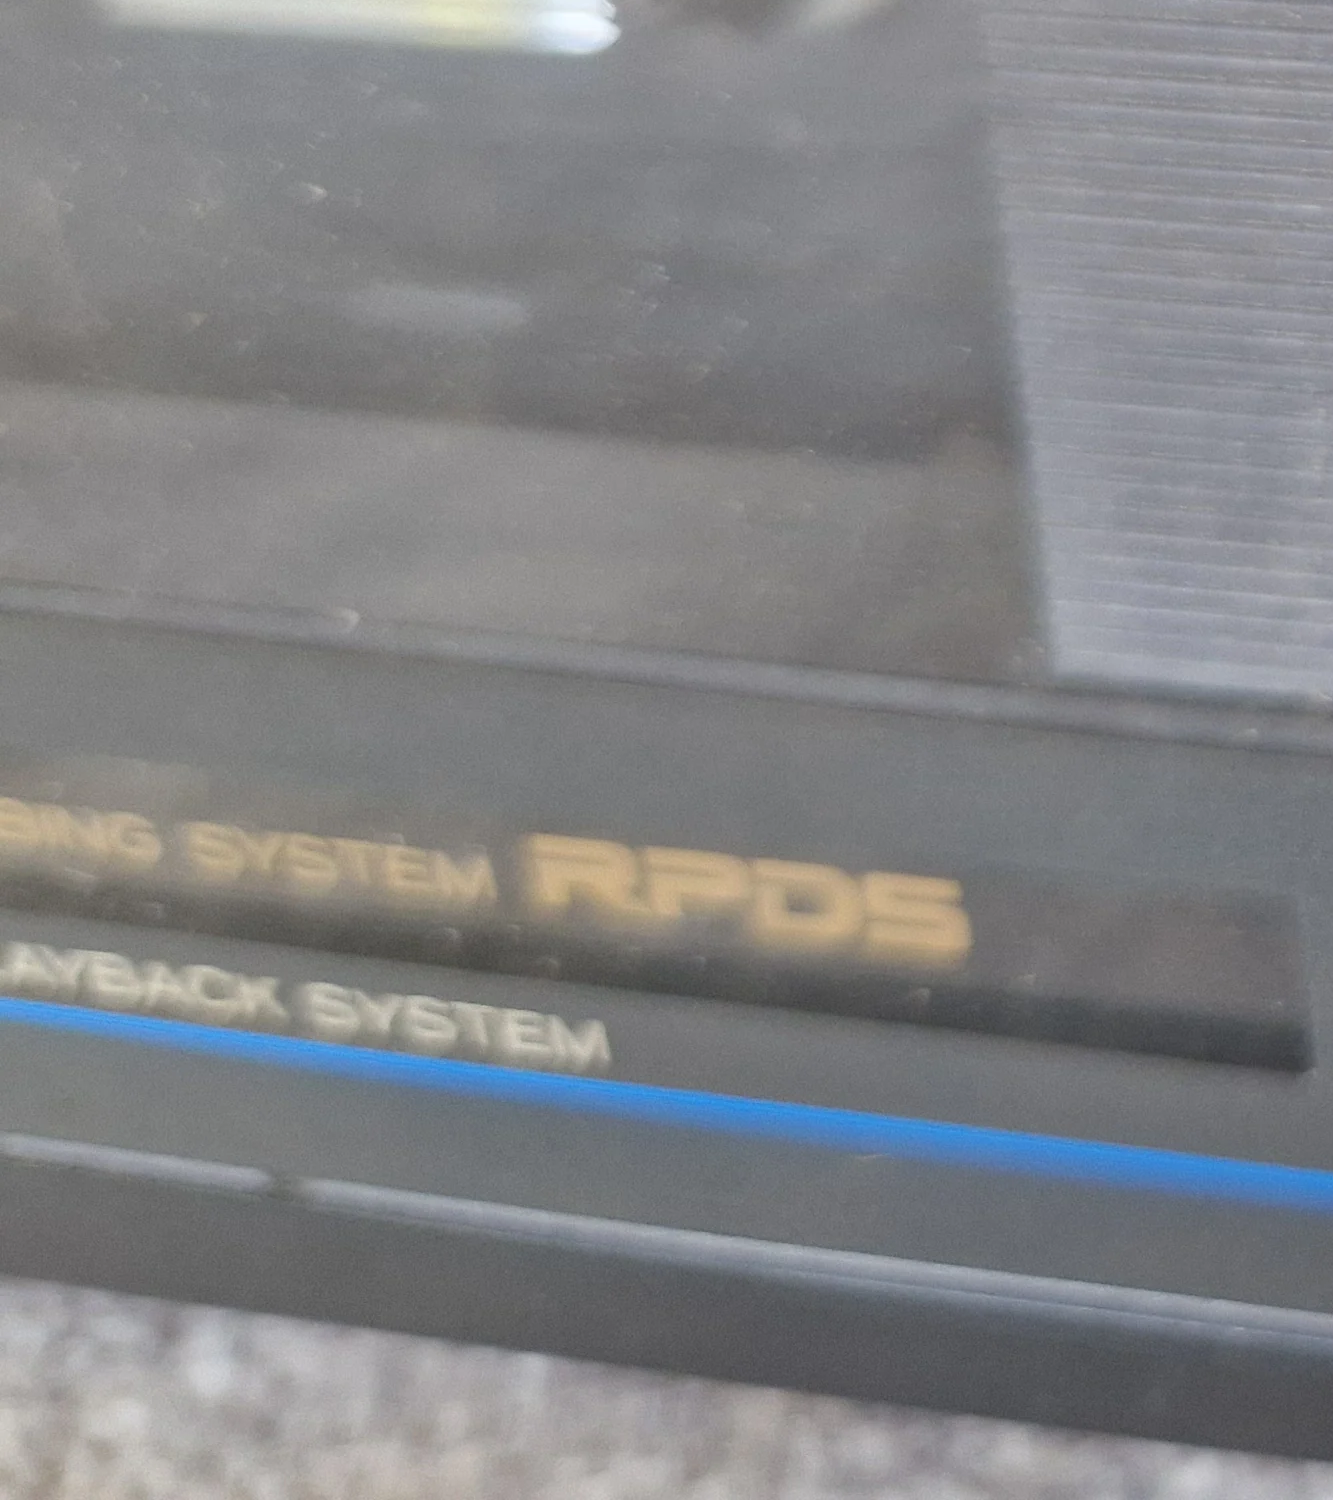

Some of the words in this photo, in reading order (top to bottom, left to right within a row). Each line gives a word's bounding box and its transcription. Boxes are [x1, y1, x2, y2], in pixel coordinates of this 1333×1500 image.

[180, 818, 500, 902] SYSTEM
[0, 938, 290, 1025] AYBACK
[300, 976, 612, 1071] SYSTEM
